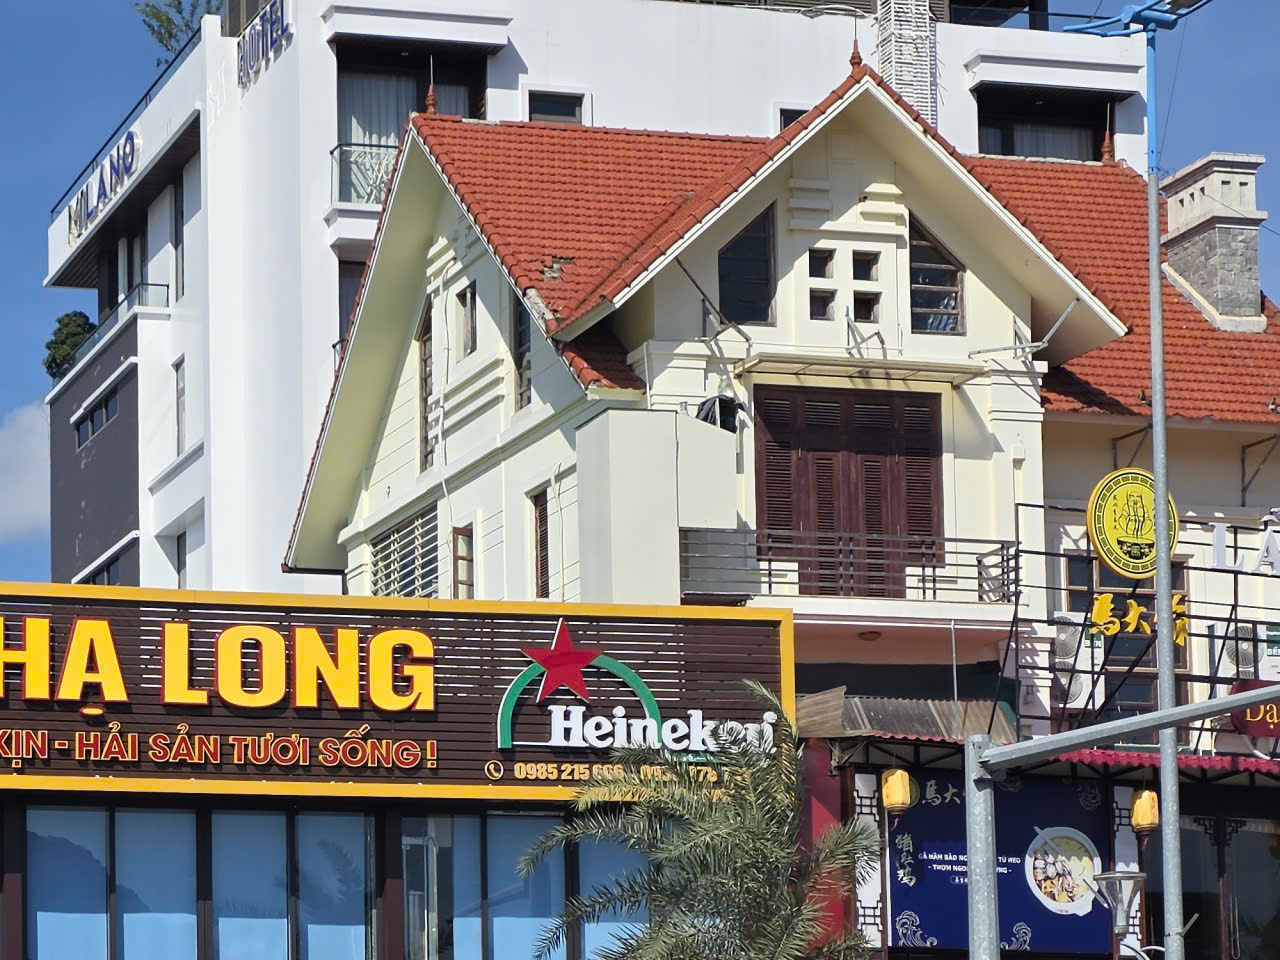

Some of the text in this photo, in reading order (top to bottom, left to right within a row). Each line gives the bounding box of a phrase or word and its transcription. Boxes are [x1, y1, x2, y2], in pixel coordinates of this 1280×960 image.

[237, 0, 292, 88] HOTEL
[67, 130, 139, 247] MILANO
[160, 621, 437, 713] LONG
[75, 721, 139, 762] HẢI
[148, 722, 220, 764] SẢN
[229, 732, 310, 766] TƯƠI
[513, 762, 558, 780] 0985
[561, 763, 590, 781] 215
